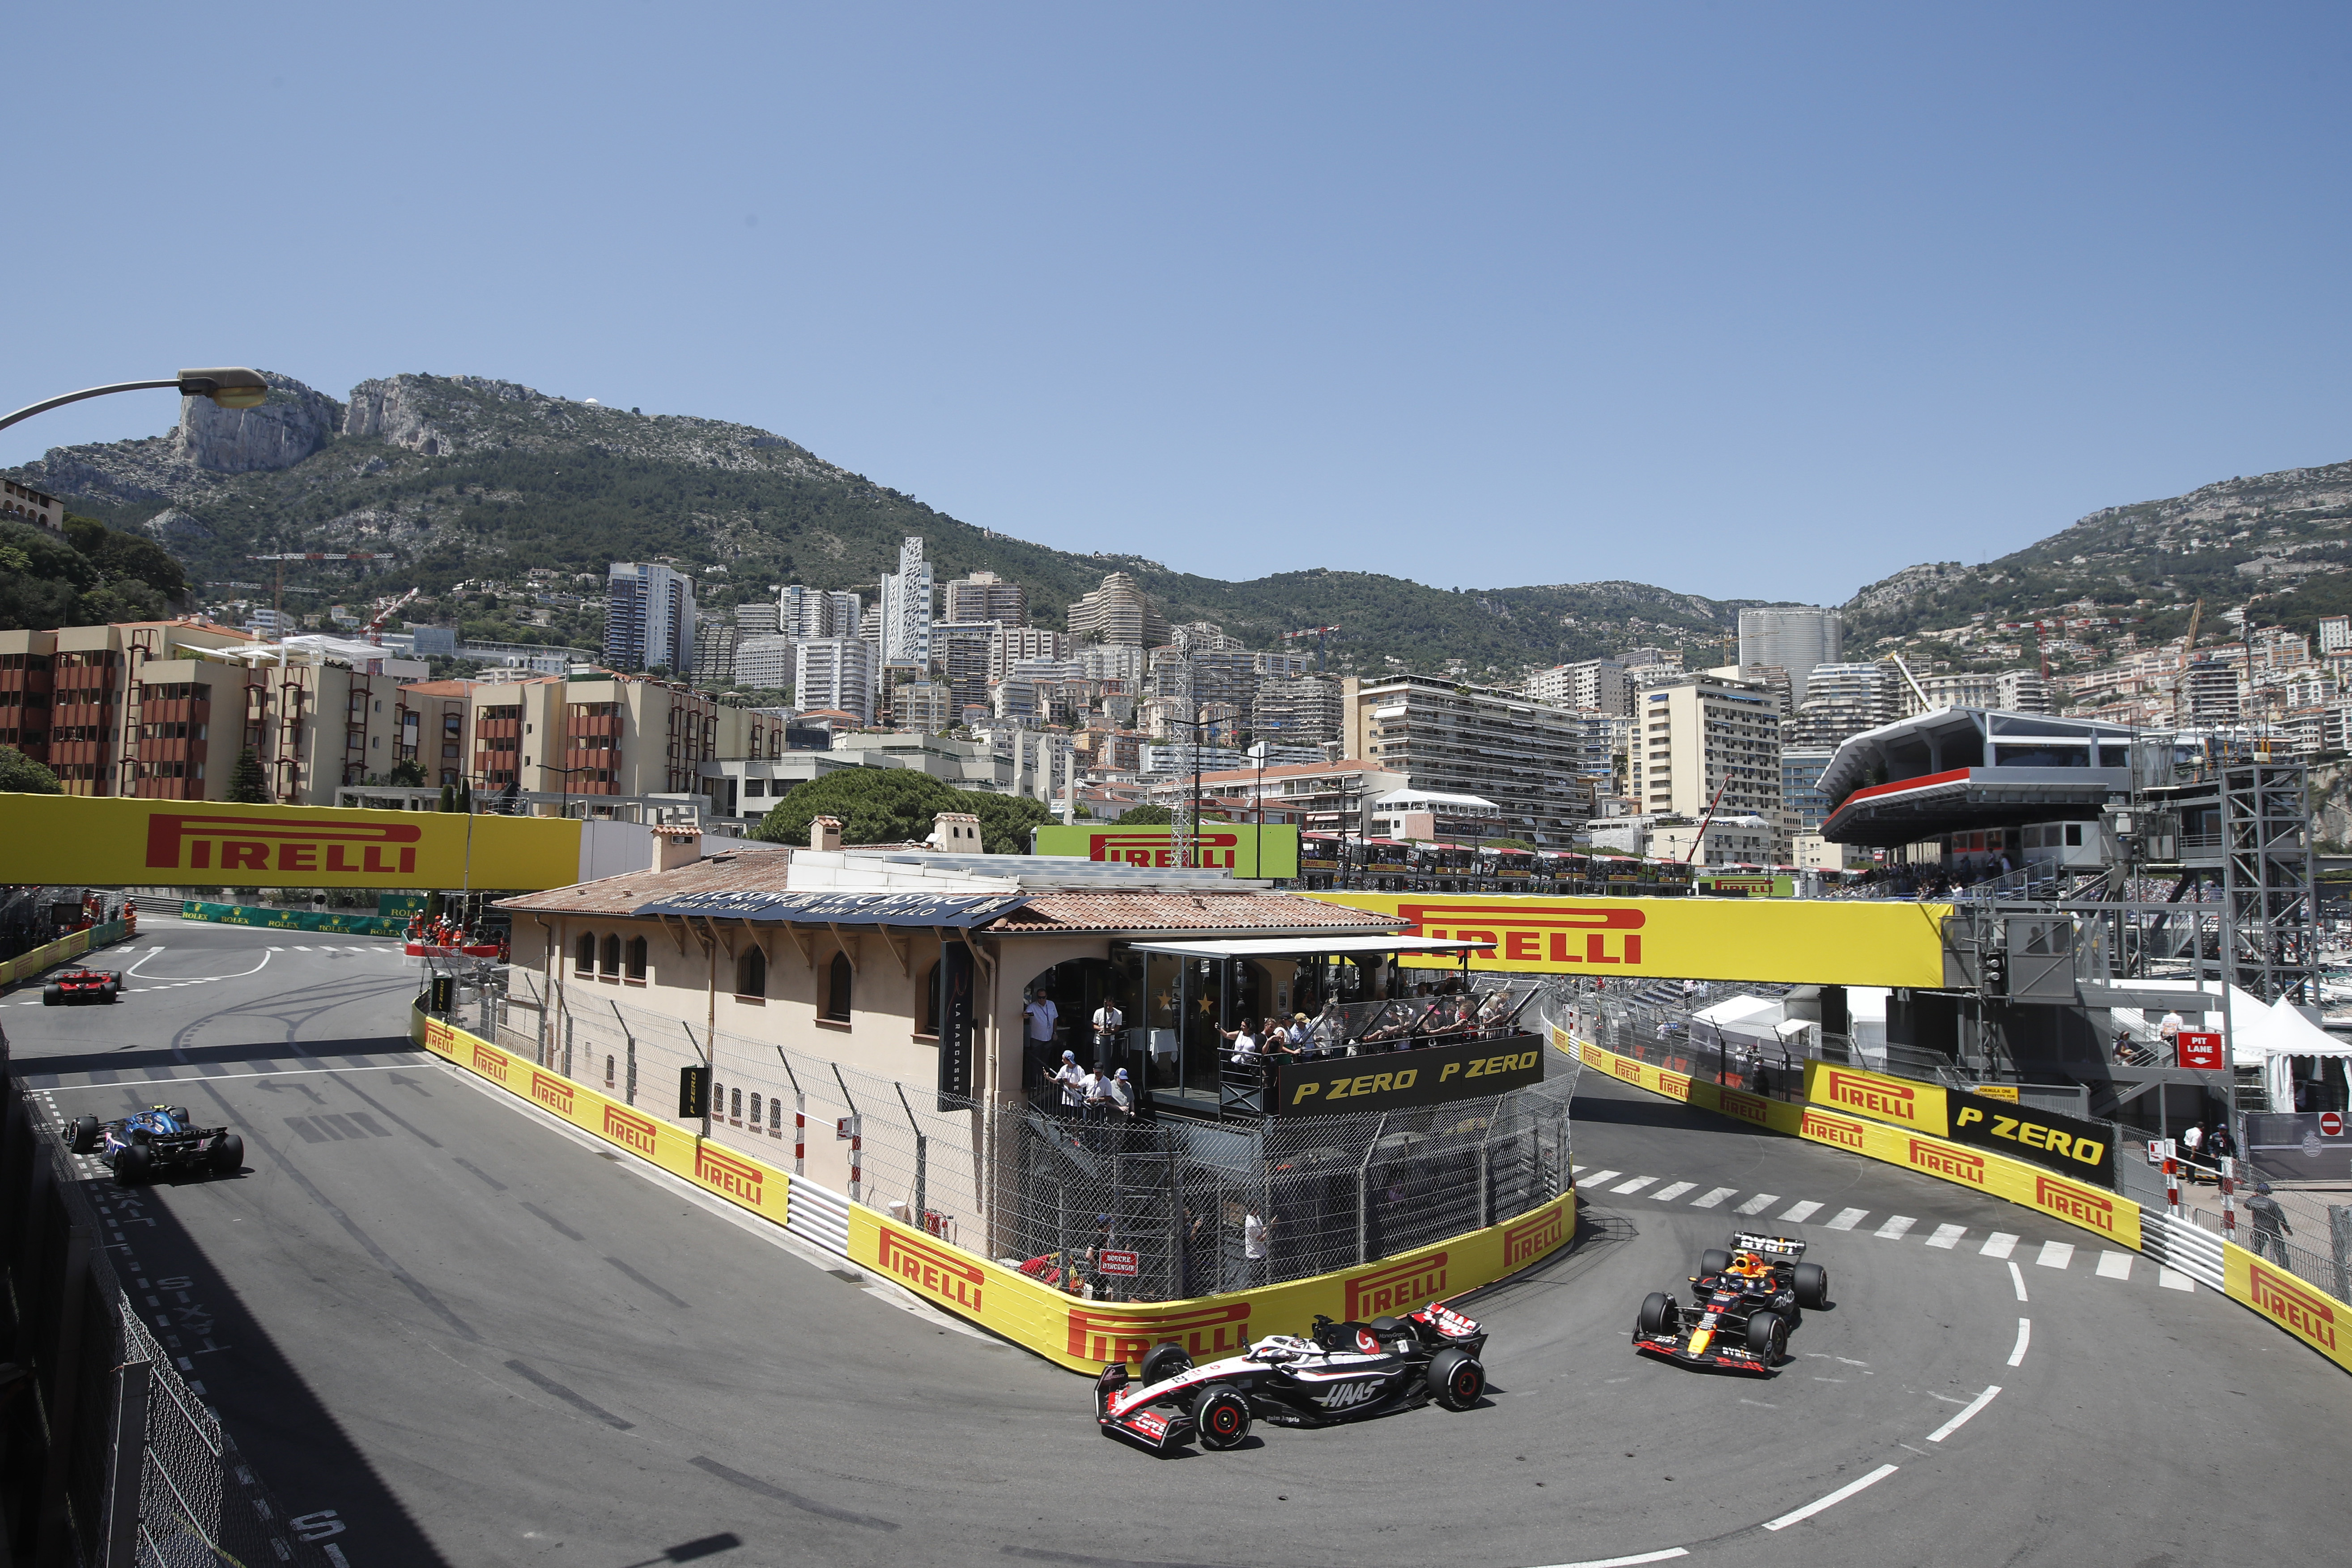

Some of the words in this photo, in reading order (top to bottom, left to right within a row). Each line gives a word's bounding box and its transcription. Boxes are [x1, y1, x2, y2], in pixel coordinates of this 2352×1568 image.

[146, 814, 421, 872] PIRELLI
[391, 909, 418, 917] ROLE
[826, 894, 856, 905] LE
[855, 894, 982, 906] CASINO
[182, 912, 208, 921] ROLEX
[221, 916, 249, 925] ROLEX
[268, 920, 299, 929] ROLEX
[319, 925, 350, 933] ROLEX
[1398, 905, 1646, 964] PIRELLI
[14, 956, 33, 978] PIRELLI
[955, 1003, 961, 1017] LA
[425, 1022, 454, 1055] PIRELLI
[473, 1045, 508, 1082] PIRELLI
[1439, 1062, 1460, 1083] P
[1465, 1051, 1538, 1078] ZERO
[1584, 1045, 1602, 1067] PIRELLI
[1615, 1058, 1640, 1083] PIRELLI
[532, 1071, 574, 1115] PIRELLI
[1292, 1083, 1319, 1105] P
[1326, 1069, 1418, 1101] ZERO
[1659, 1073, 1693, 1100] PIRELLI
[1829, 1071, 1914, 1120] PIRELLI
[690, 1105, 694, 1114] P
[1720, 1091, 1767, 1123] PIRELLI
[162, 1128, 218, 1139] ALPINE
[604, 1104, 656, 1156] PIRELLI
[1802, 1112, 1863, 1148] PIRELLI
[1956, 1106, 1983, 1126] P
[1991, 1114, 2104, 1165] ZERO
[695, 1145, 763, 1206] PIRELLI
[1910, 1139, 1984, 1185] PIRELLI
[2037, 1176, 2113, 1232] PIRELLI
[1504, 1206, 1562, 1268] PIRELLI
[879, 1226, 984, 1313] PIRELLI
[1345, 1252, 1449, 1322] PIRELLI
[1706, 1304, 1725, 1314] 11
[2250, 1264, 2335, 1351] PIRELLI
[1310, 1378, 1386, 1407] HAAS
